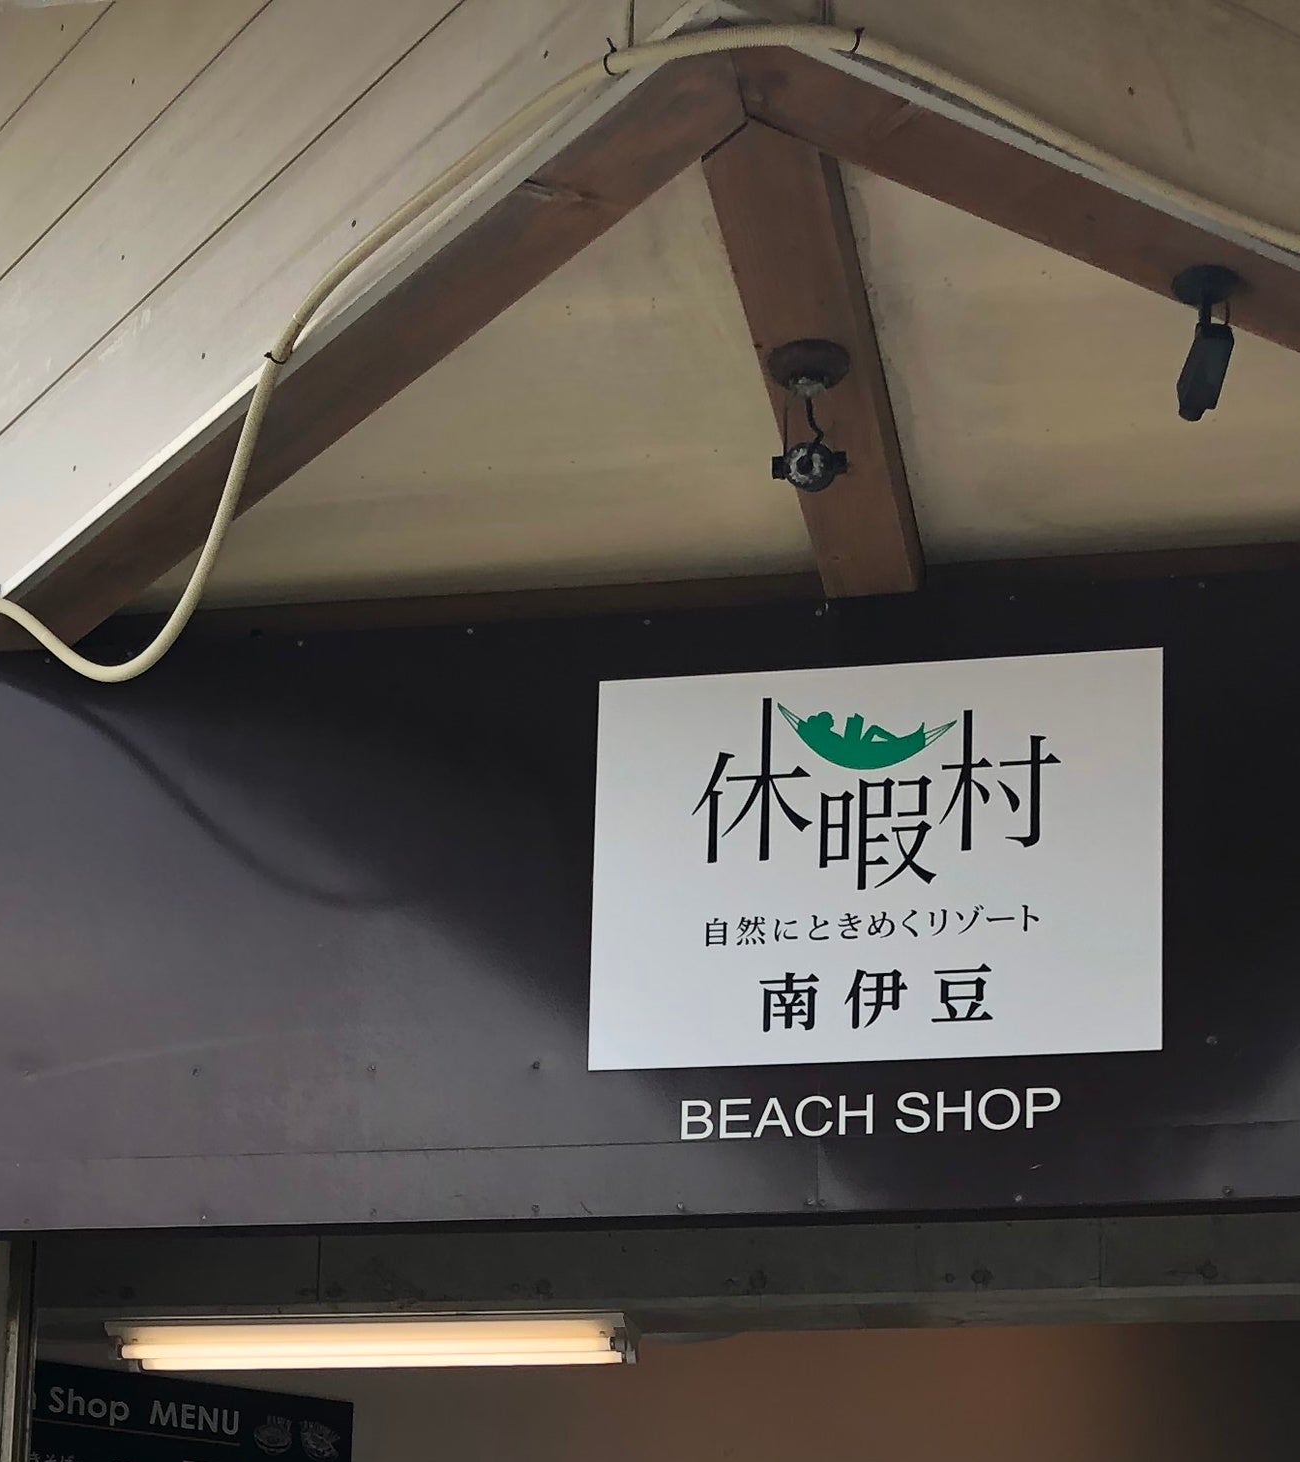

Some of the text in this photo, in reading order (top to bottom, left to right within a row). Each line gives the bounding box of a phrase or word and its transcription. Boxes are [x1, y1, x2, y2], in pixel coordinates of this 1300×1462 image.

[691, 697, 1061, 890] 休暇村
[704, 905, 1040, 947] 自然にときめくリゾート
[759, 963, 995, 1033] 南伊豆
[680, 1087, 1061, 1141] BEACH SHOP
[48, 1386, 241, 1436] Shop MENU
